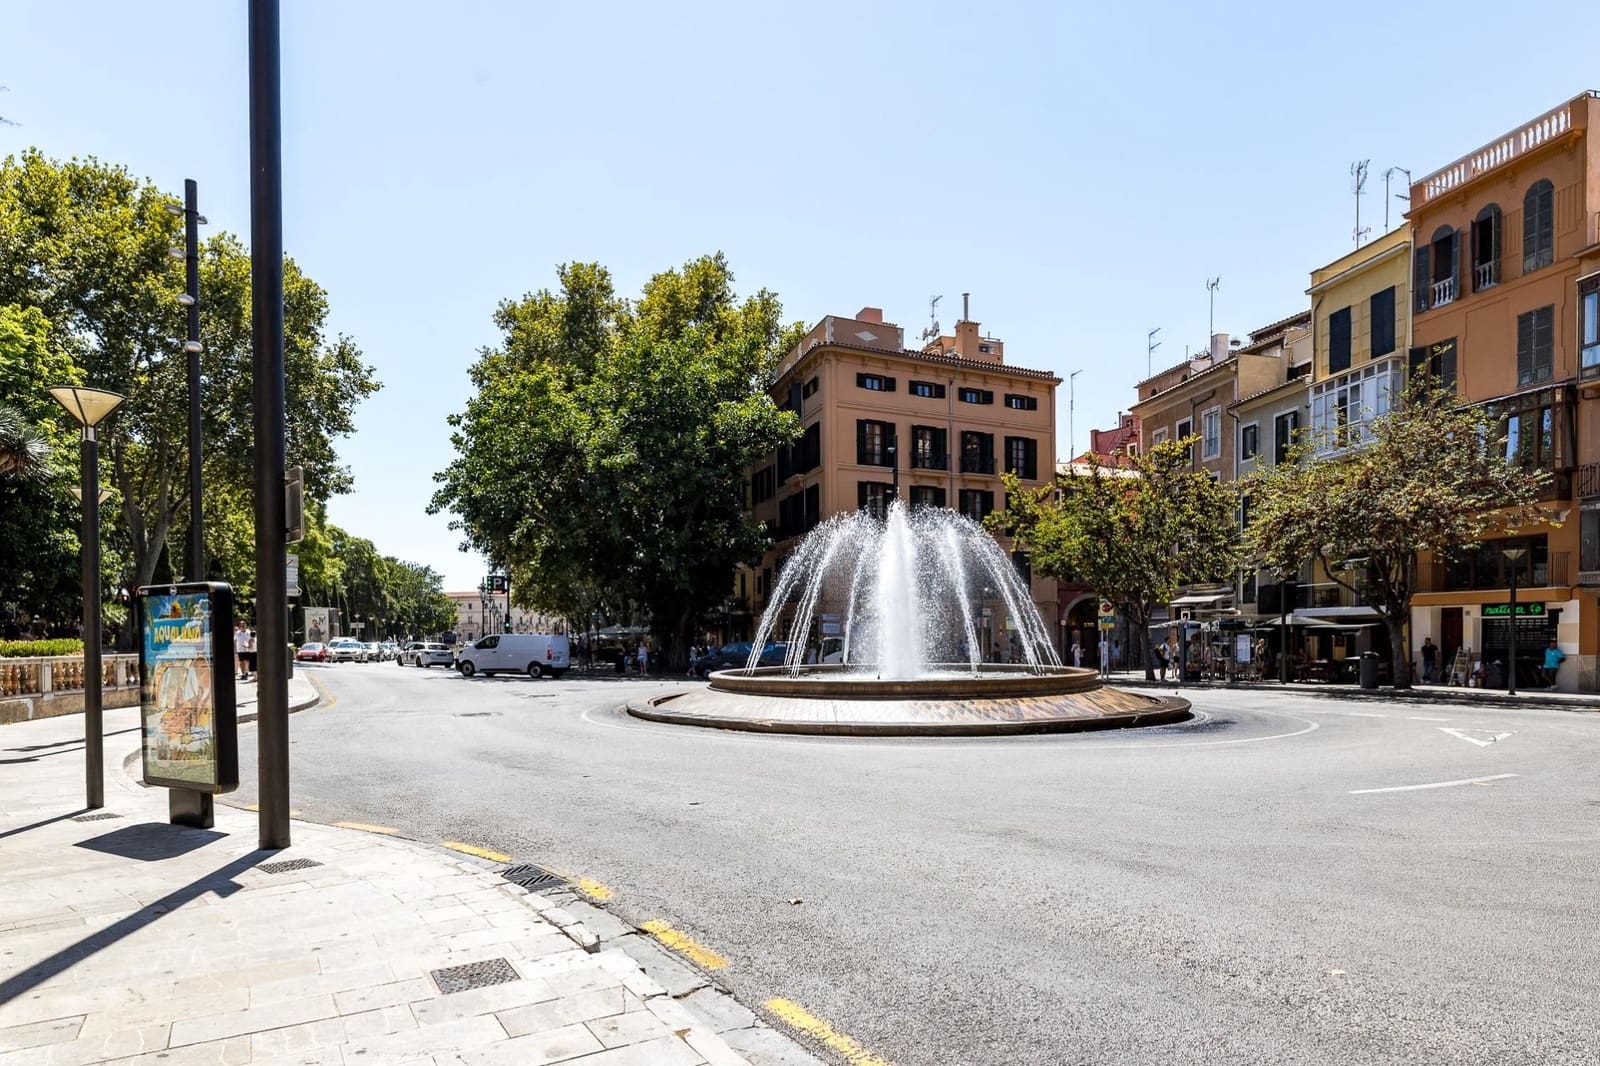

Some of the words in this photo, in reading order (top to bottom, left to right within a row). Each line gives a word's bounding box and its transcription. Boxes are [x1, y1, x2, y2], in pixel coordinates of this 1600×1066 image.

[493, 577, 502, 589] P
[1485, 605, 1526, 615] natua
[154, 625, 201, 643] AQUALAND
